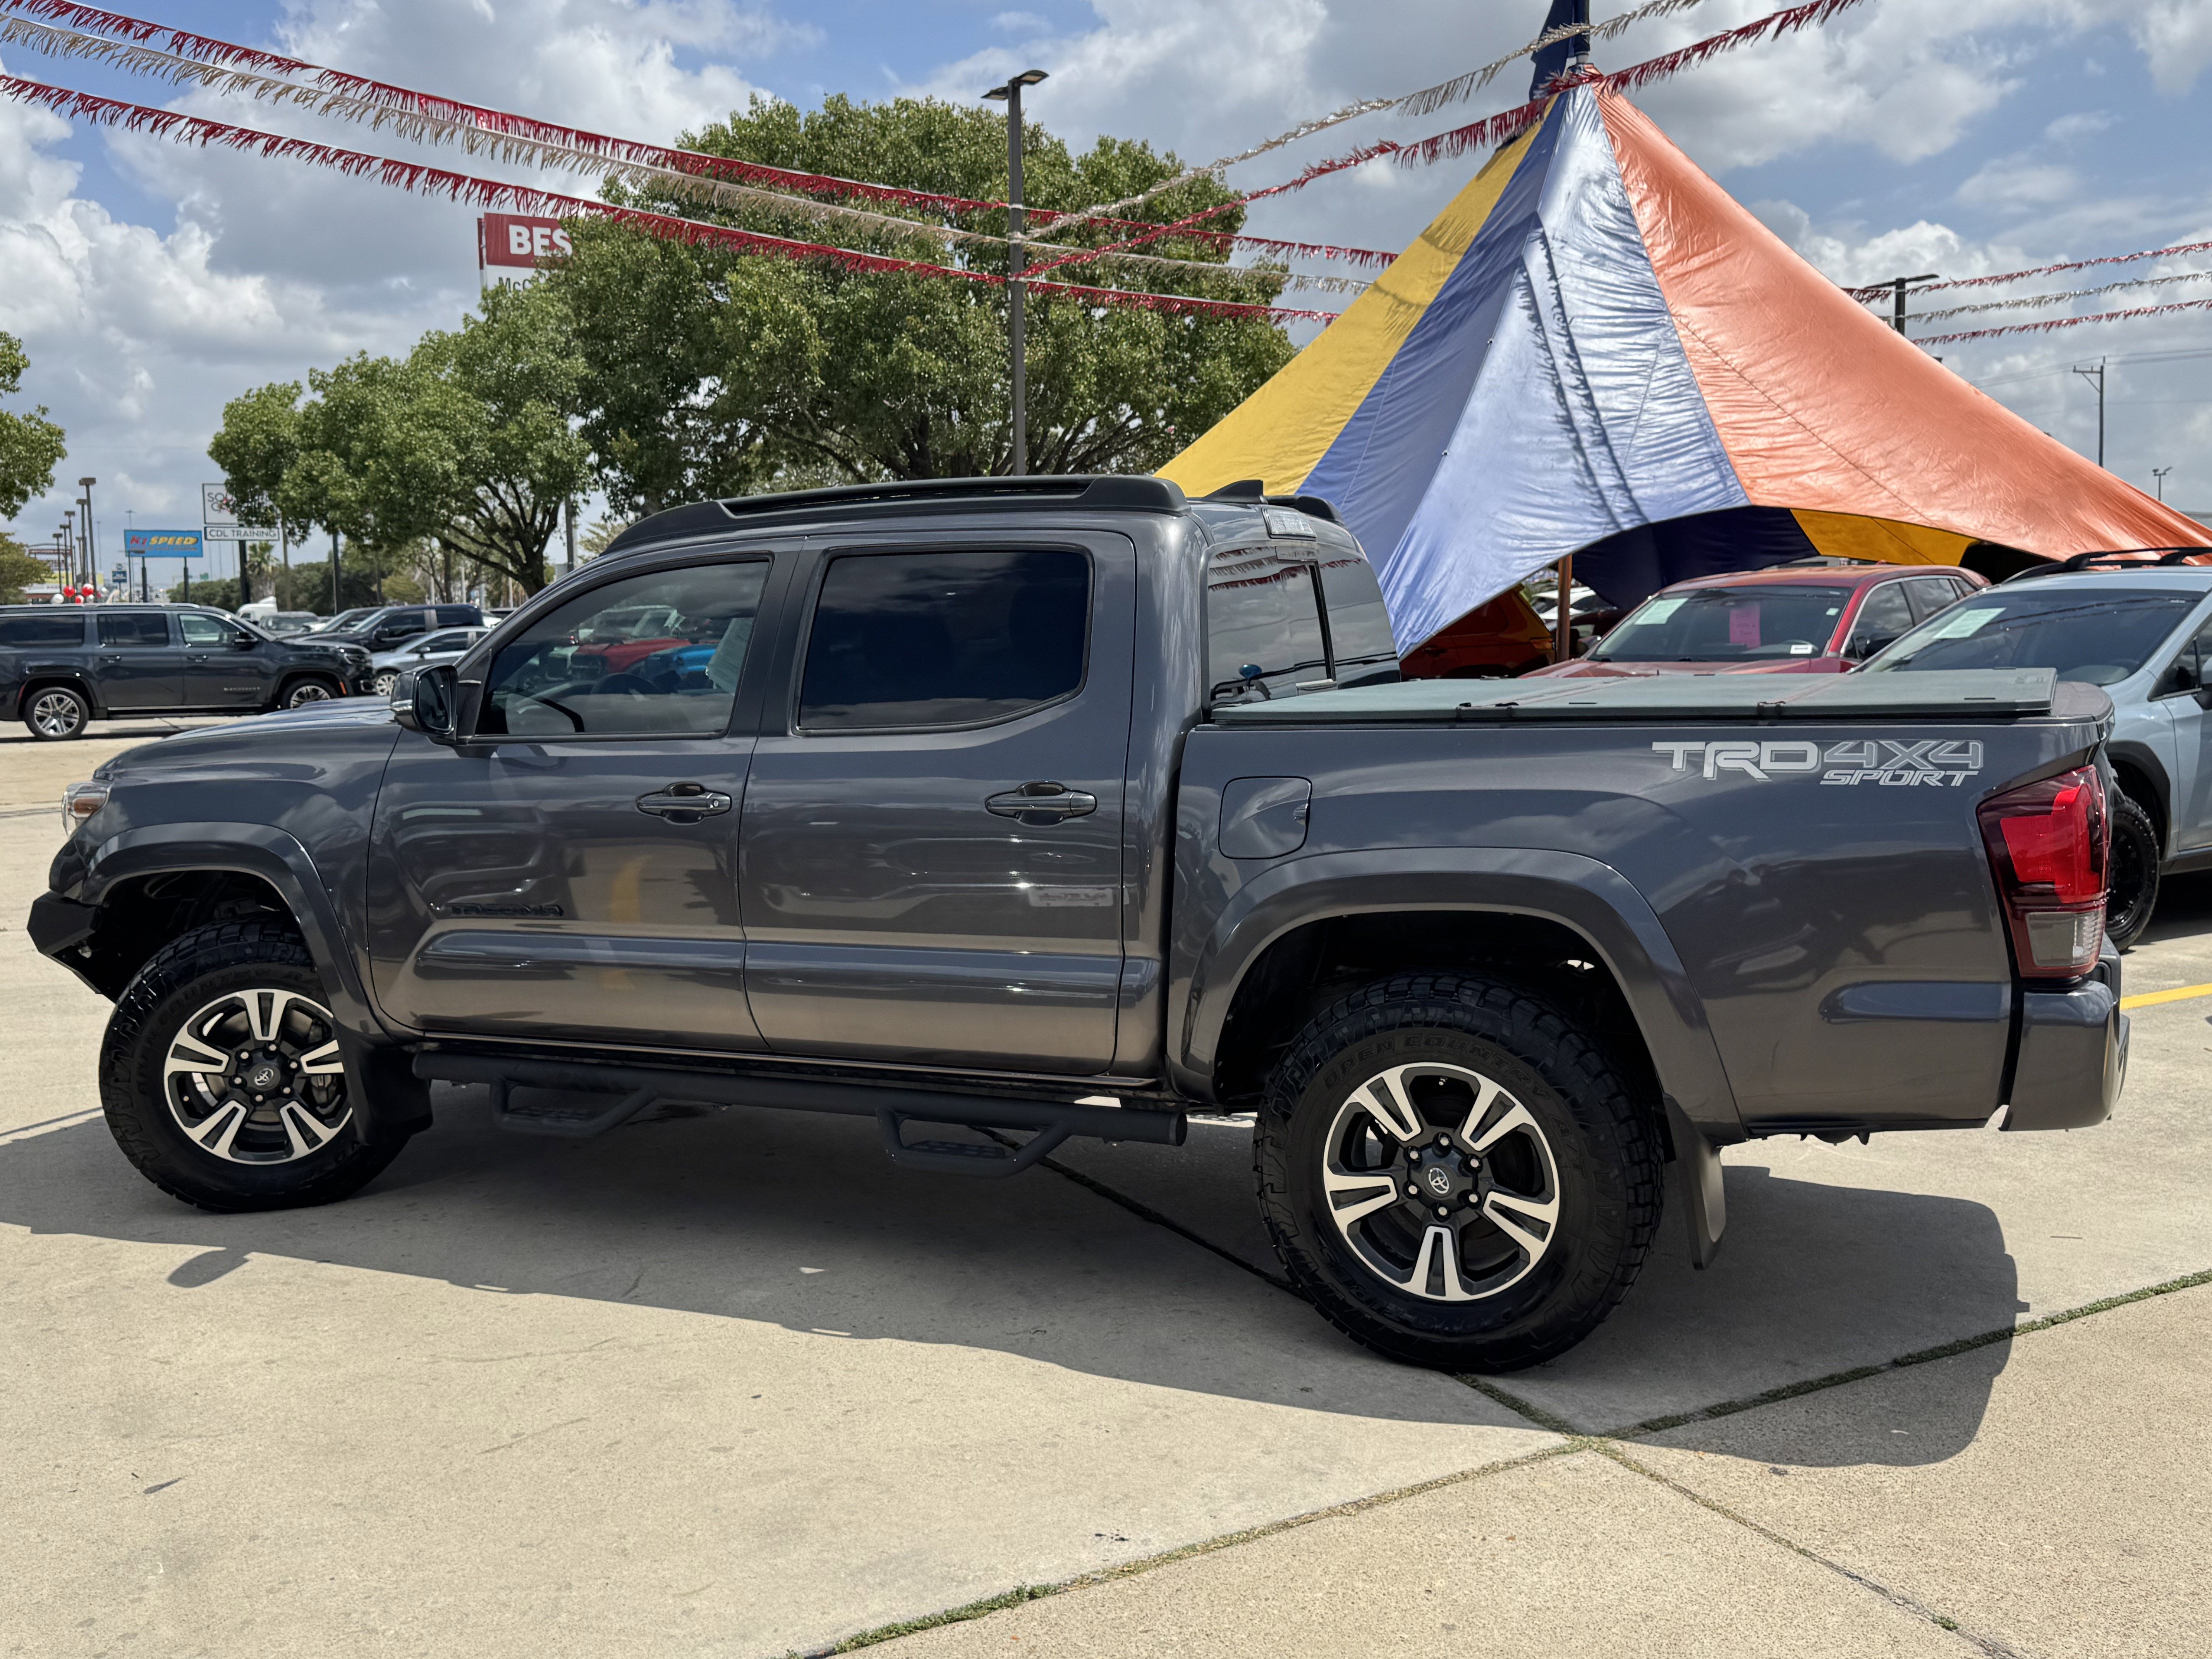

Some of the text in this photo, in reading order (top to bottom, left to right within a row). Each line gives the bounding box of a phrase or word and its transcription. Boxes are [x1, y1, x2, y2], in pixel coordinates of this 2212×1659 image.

[149, 536, 199, 545] SPEED
[209, 529, 276, 538] CDL TRAINING
[1652, 740, 1984, 781] TRD 4X4
[1819, 769, 1979, 787] SPORT
[1323, 1038, 1395, 1089] OPEN
[1405, 1034, 1549, 1099] COUNTRY
